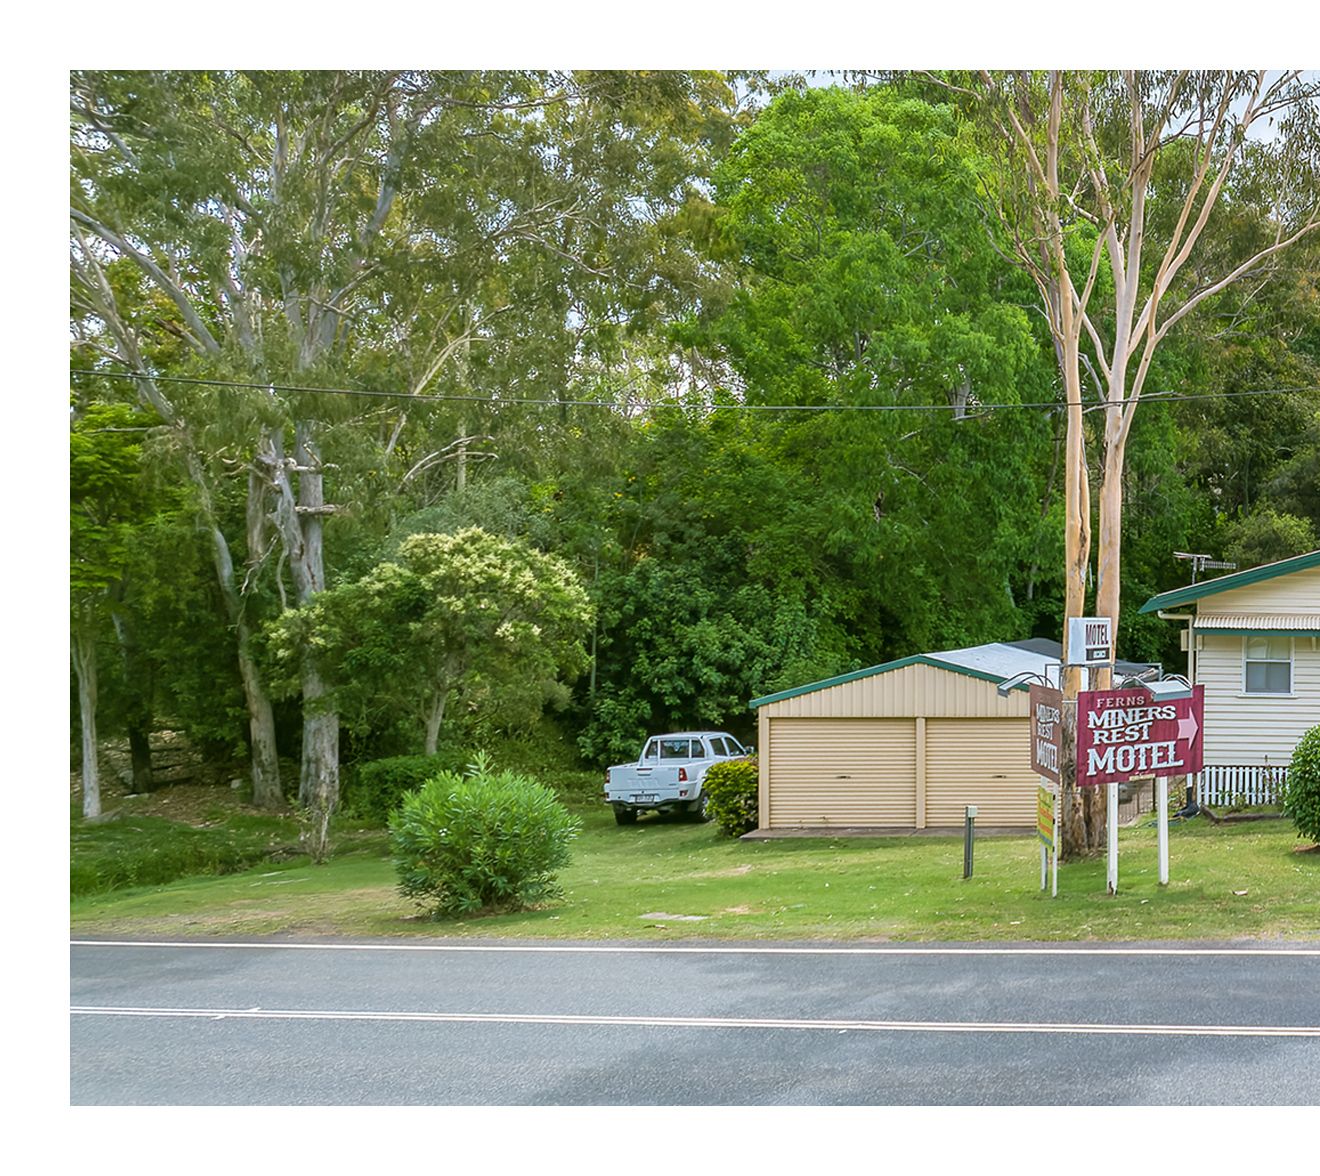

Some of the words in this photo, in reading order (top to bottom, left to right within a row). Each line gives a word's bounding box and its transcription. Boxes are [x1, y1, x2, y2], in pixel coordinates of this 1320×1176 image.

[1085, 624, 1109, 646] MOTEL
[1096, 695, 1145, 709] FERNS
[1087, 705, 1177, 730] MINERS
[1092, 722, 1153, 745] REST
[1086, 741, 1184, 776] MOTEL
